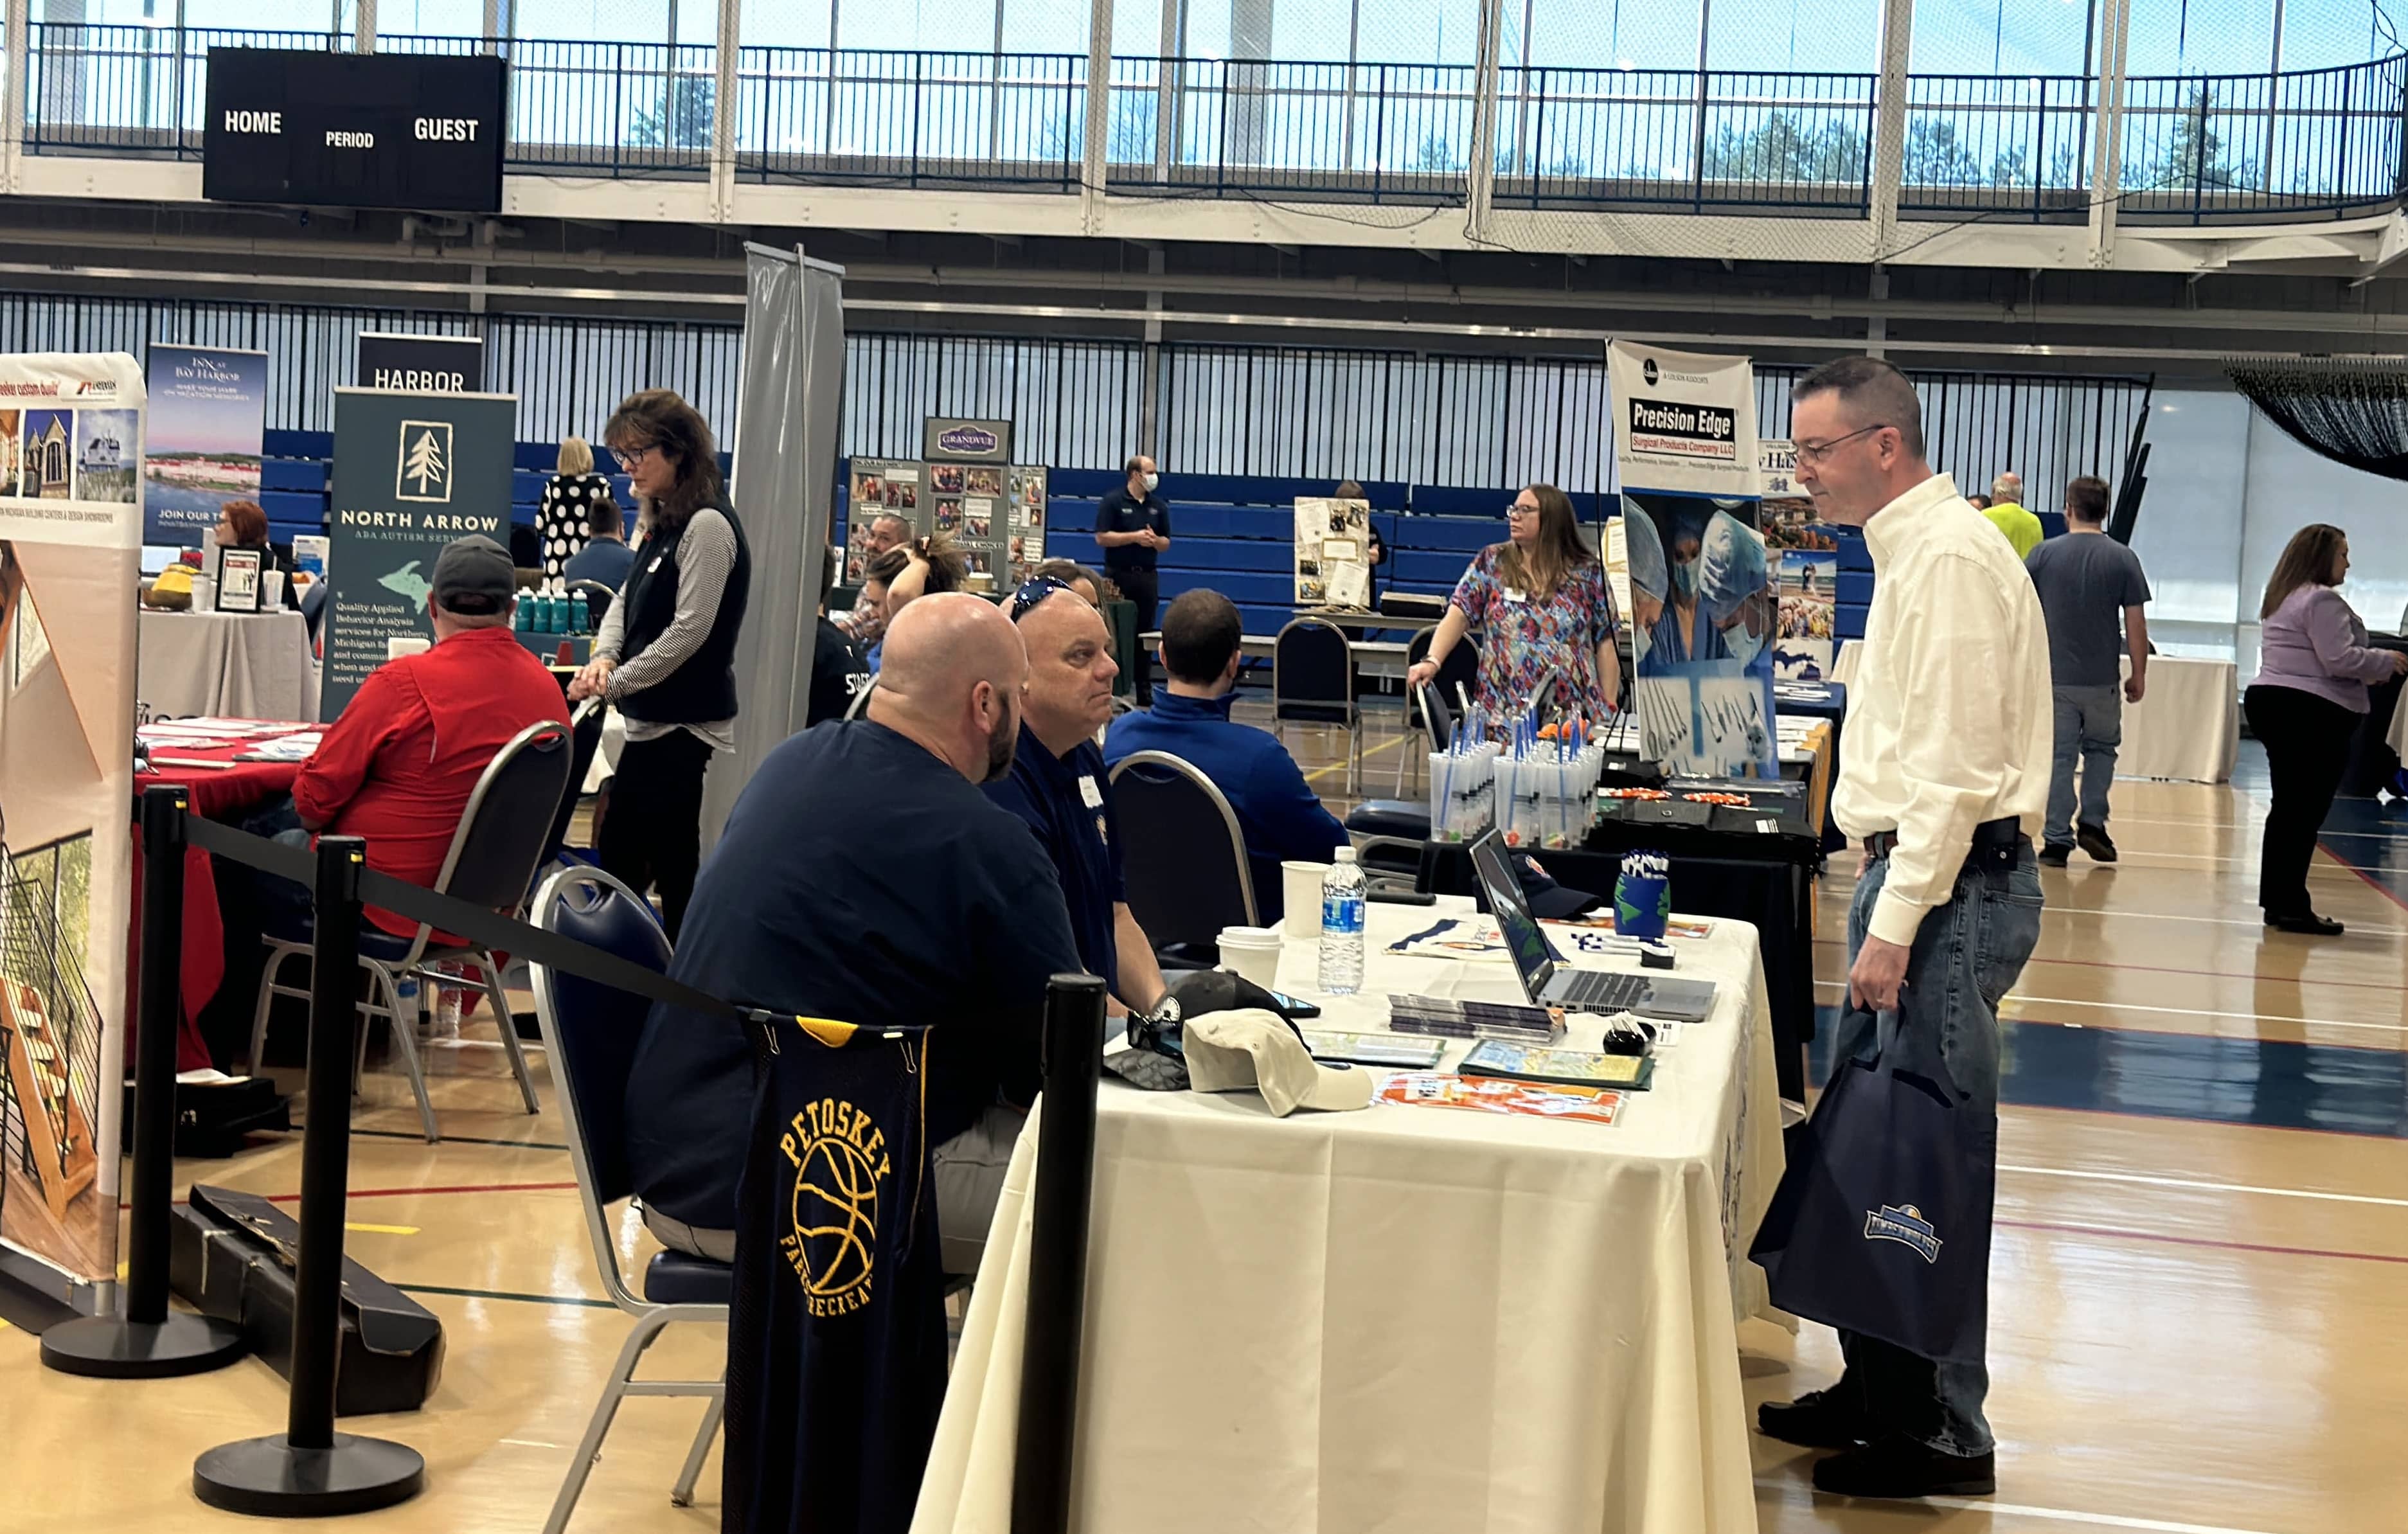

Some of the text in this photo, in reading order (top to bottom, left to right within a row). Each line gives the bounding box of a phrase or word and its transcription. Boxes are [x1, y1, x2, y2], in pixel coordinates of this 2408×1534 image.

[225, 111, 281, 134] HOME
[415, 118, 478, 141] GUEST
[326, 131, 374, 148] PERIOD
[175, 366, 241, 383] BAY HARBOR
[375, 368, 465, 393] HARBOR
[1634, 403, 1731, 439] Precision Edge
[942, 435, 994, 445] GRANDVUE
[1632, 436, 1734, 455] Surgical Products Company LLC
[158, 509, 184, 519] JOIN
[186, 511, 210, 521] OUR
[341, 510, 498, 532] NORTH ARROW
[355, 530, 461, 544] ABA AUTISM SERV
[336, 602, 404, 614] Quality Applied
[335, 614, 414, 627] Behavior Analysis
[373, 628, 386, 637] for
[388, 628, 428, 638] Northern
[334, 638, 376, 649] Michigan
[333, 662, 376, 672] when and
[332, 675, 356, 684] need
[780, 1098, 891, 1181] PETOSKEY
